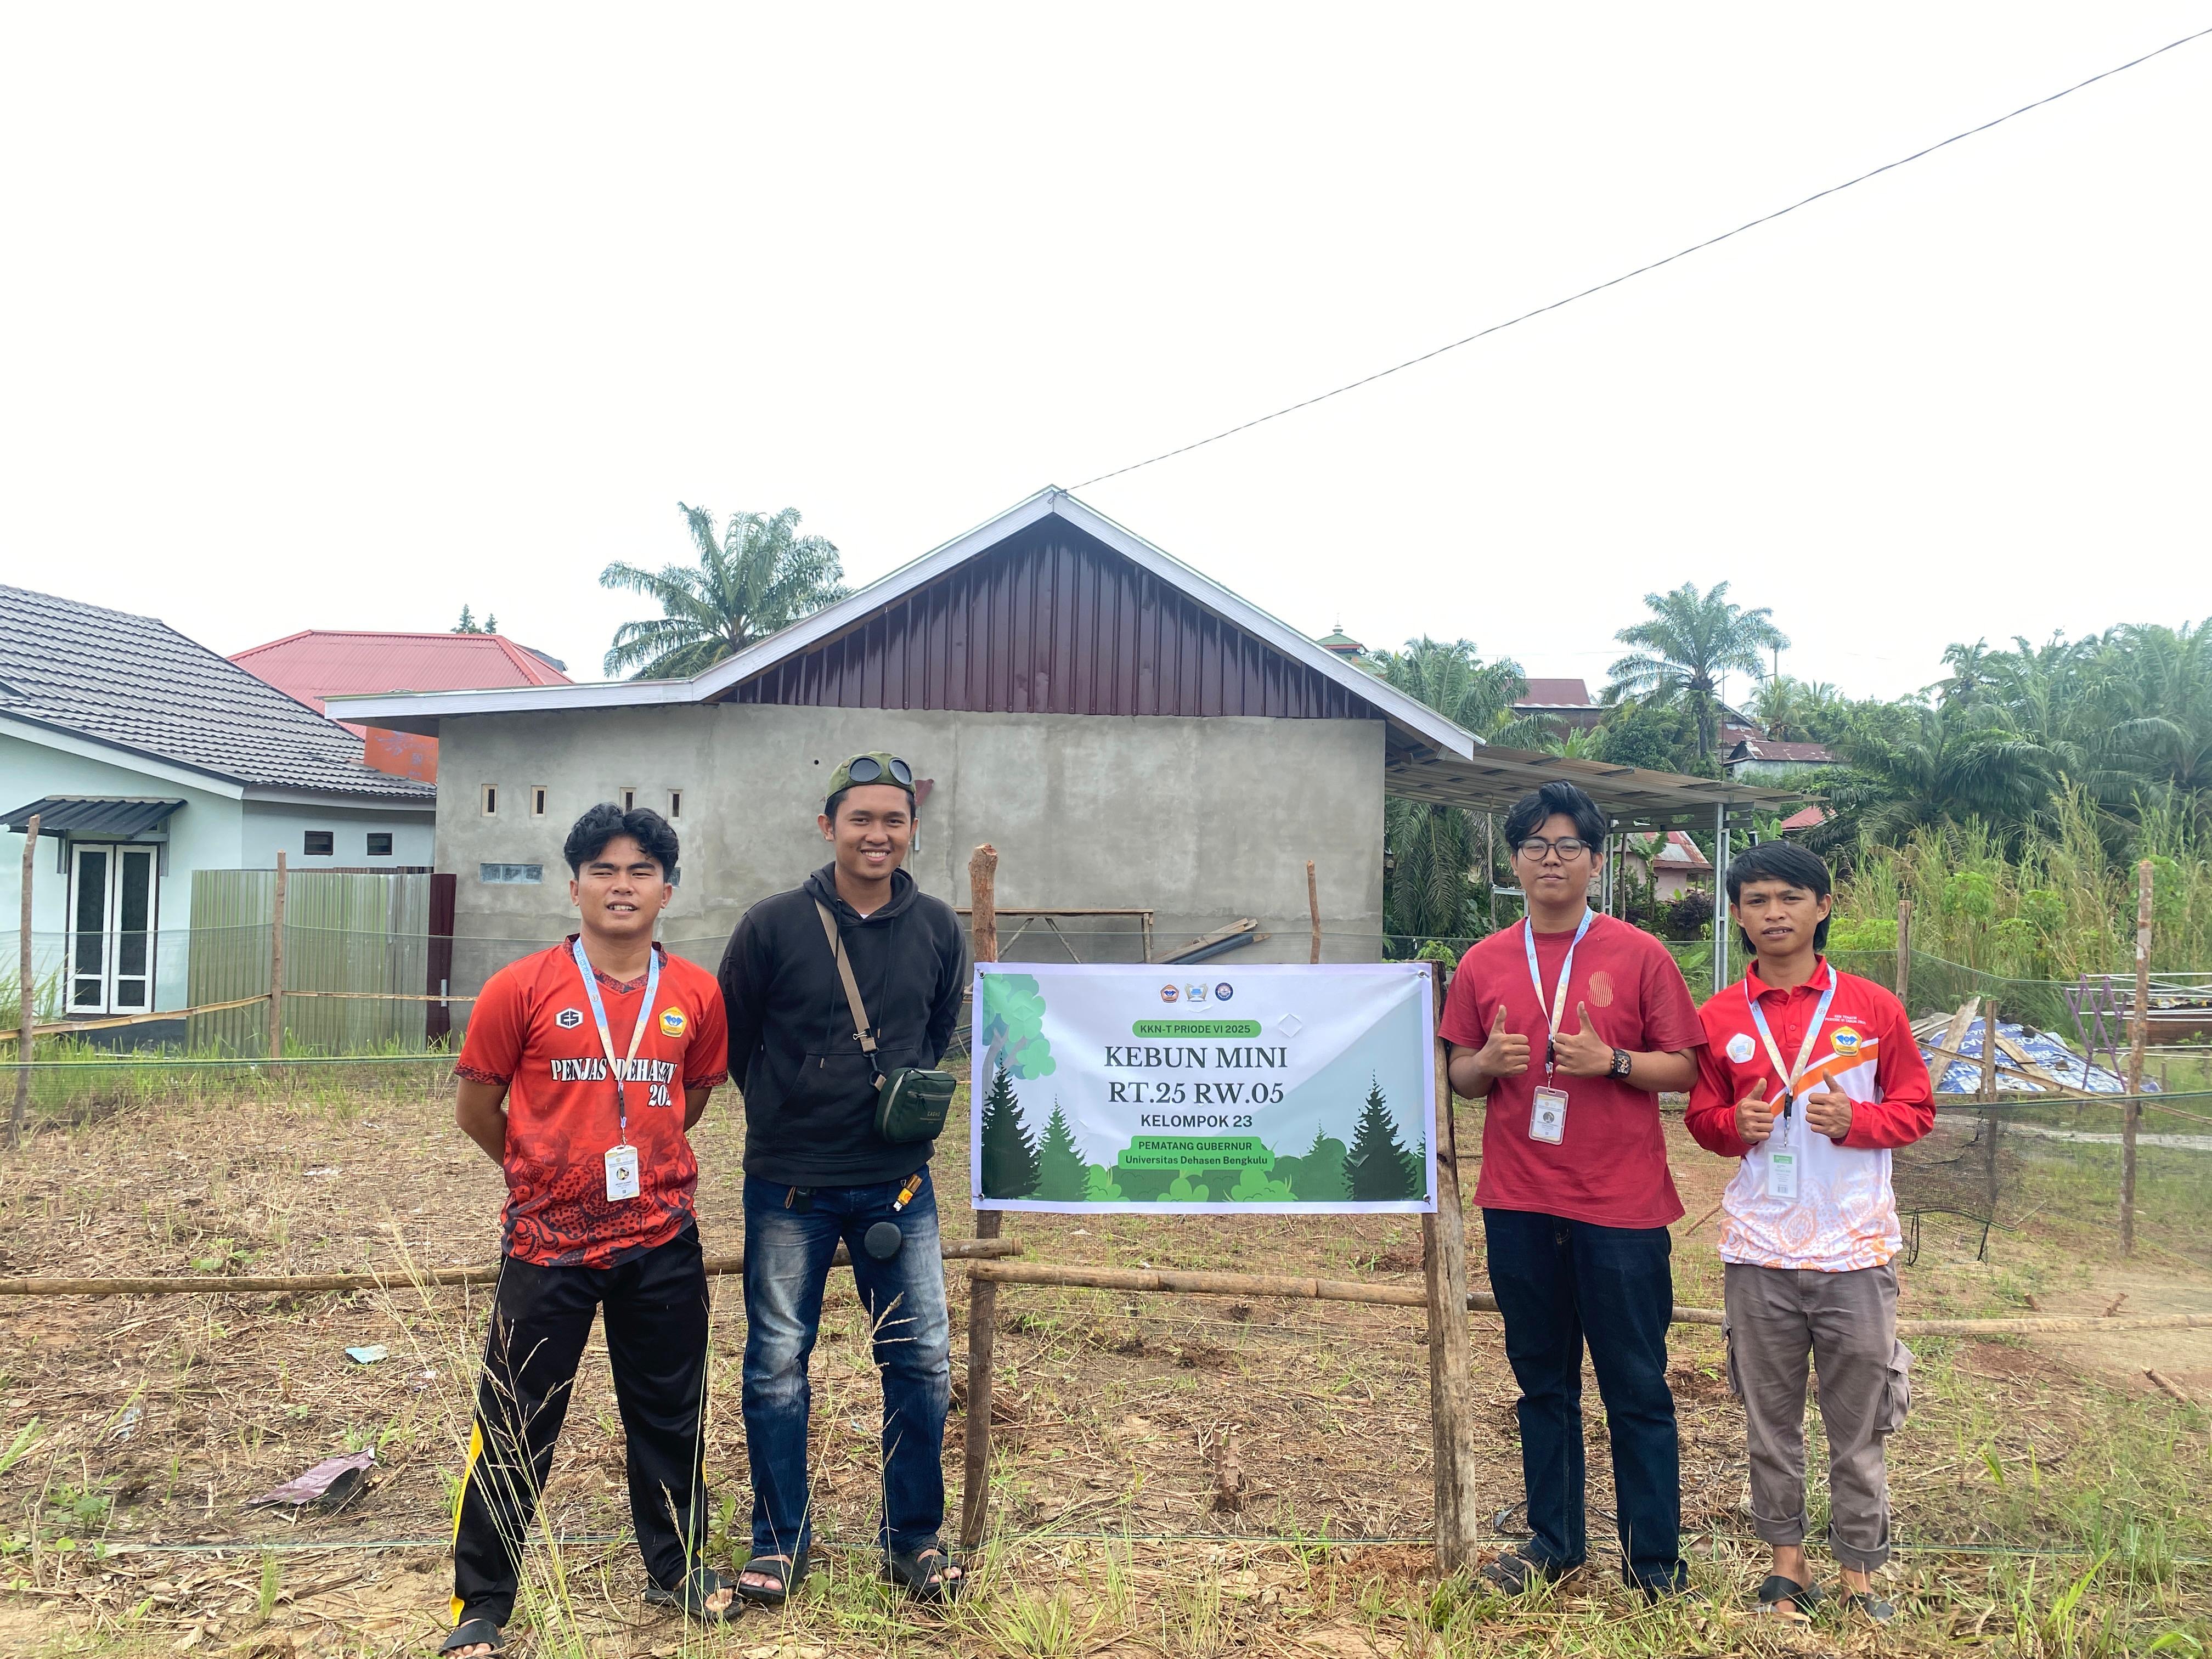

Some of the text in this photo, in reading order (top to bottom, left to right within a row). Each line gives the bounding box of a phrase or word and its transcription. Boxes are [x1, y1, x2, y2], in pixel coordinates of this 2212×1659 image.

[1140, 1025, 1251, 1034] KKN-T PRIODE VI 2025
[1104, 1046, 1288, 1068] KEBUN MINI
[550, 1058, 608, 1081] PENJAS
[1108, 1081, 1284, 1104] RT.25 RW.05
[1141, 1114, 1252, 1127] KELOMPOK 23
[1139, 1141, 1252, 1150] PEMATANG GUBERNUR
[1126, 1155, 1267, 1166] Universitas Dehasen Bengkulu
